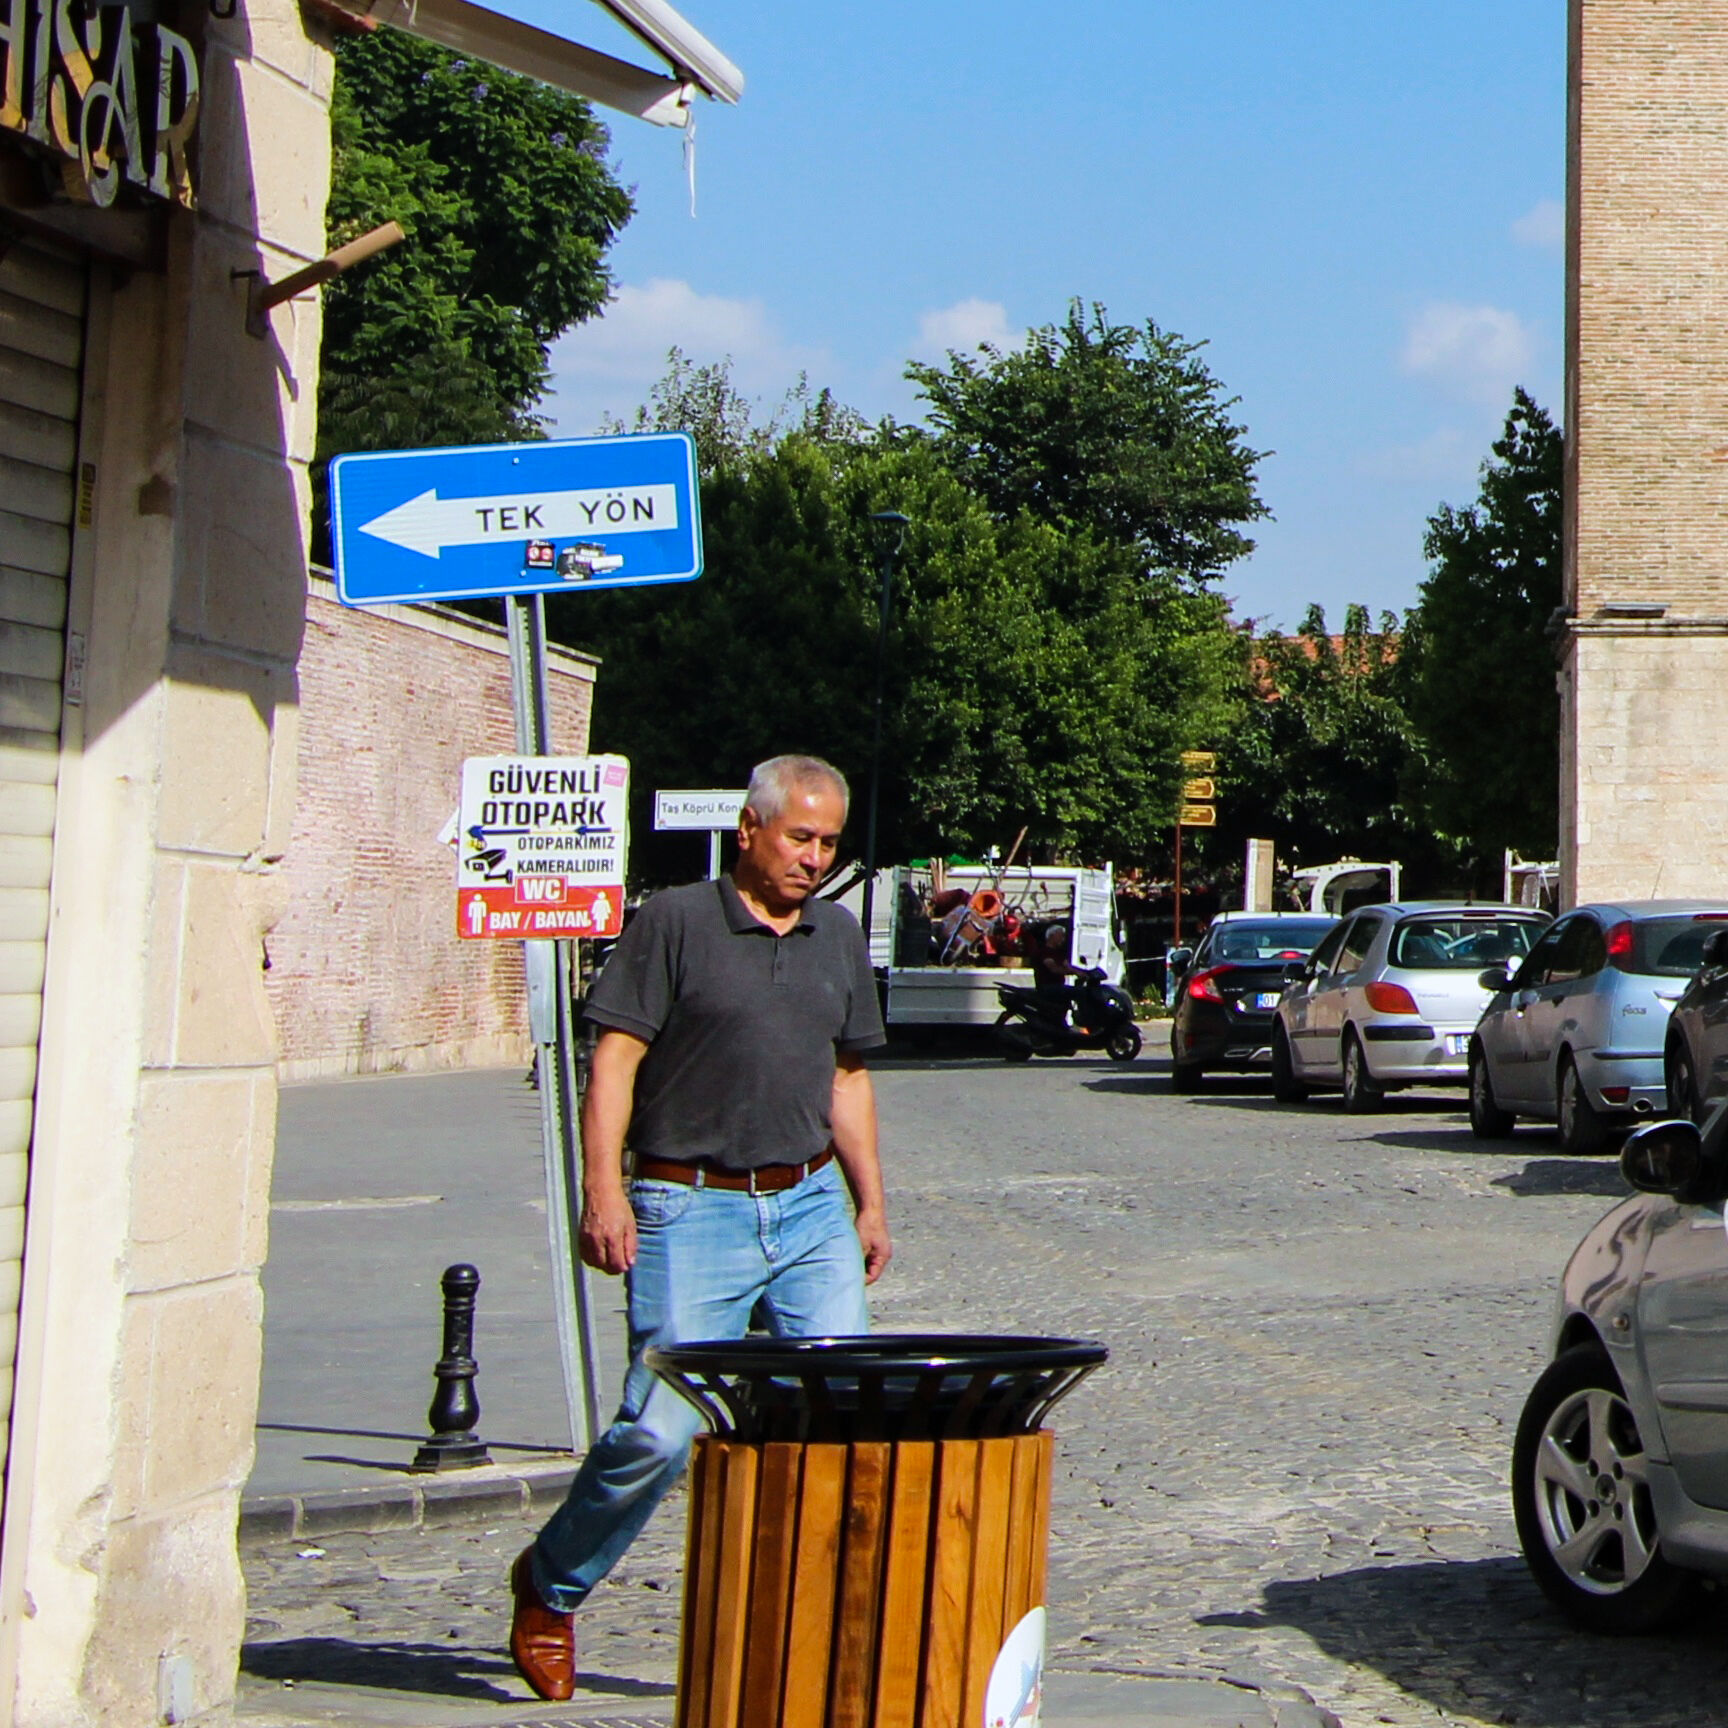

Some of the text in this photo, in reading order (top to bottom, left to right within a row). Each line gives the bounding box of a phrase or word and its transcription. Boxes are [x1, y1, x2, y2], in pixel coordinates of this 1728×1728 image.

[476, 492, 655, 532] TEK YÖN
[489, 764, 601, 794] GÜVENLİ
[482, 799, 606, 825] OTOPARK
[683, 802, 714, 816] Köprü
[718, 803, 741, 813] Kon
[517, 859, 614, 872] KAMERALIDIR!
[522, 878, 562, 901] WC
[489, 911, 522, 929] BAY
[535, 910, 588, 929] BAYAN
